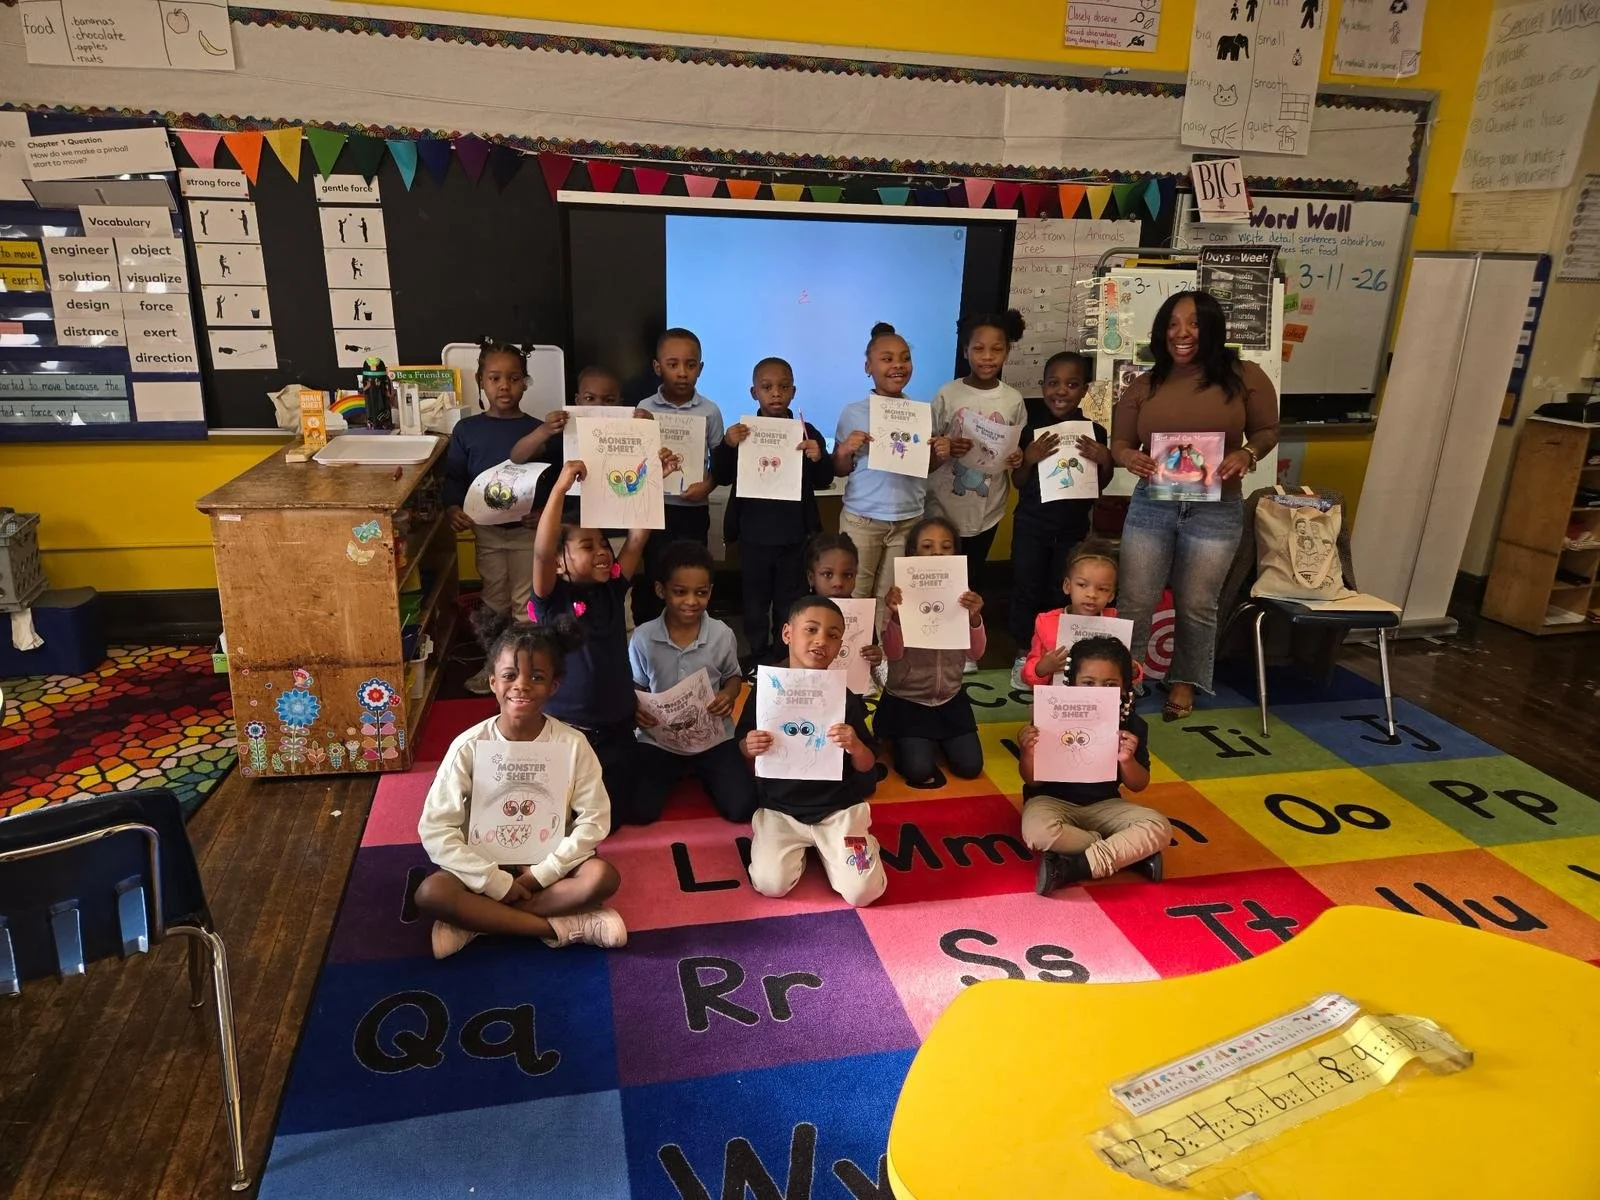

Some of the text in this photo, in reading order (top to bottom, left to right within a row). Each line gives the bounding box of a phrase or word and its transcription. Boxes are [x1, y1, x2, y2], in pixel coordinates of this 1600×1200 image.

[24, 14, 56, 35] food
[1195, 27, 1212, 48] big
[1257, 32, 1285, 47] small
[1183, 122, 1207, 134] noisy
[28, 139, 59, 149] Chapter
[68, 137, 103, 145] Question
[31, 151, 48, 159] How
[74, 147, 95, 155] make
[104, 145, 129, 155] pinball
[33, 160, 51, 168] start
[186, 178, 240, 188] strong force
[1196, 161, 1242, 201] BIG
[321, 184, 373, 193] gentle force
[1250, 202, 1351, 232] Word Wall
[88, 217, 151, 229] Vocabulary
[1016, 224, 1037, 240] ood
[1086, 224, 1125, 242] Animals
[1209, 232, 1229, 241] can
[51, 245, 109, 256] engineer
[131, 244, 171, 257] object
[1206, 252, 1230, 263] Days
[1240, 252, 1268, 263] Week
[58, 272, 111, 282] solution
[127, 272, 182, 284] visualize
[66, 299, 110, 311] design
[140, 301, 174, 311] force
[63, 327, 119, 337] distance
[143, 327, 178, 337] exert
[135, 353, 193, 363] direction
[414, 371, 440, 379] Friend
[65, 379, 100, 391] because
[599, 437, 642, 446] MONSTER
[607, 445, 634, 453] SHEET
[919, 579, 942, 587] SHEET
[777, 689, 823, 698] MONSTER
[786, 697, 813, 705] SHEET
[1062, 711, 1089, 719] SHEET
[1181, 725, 1272, 758] Ii
[497, 763, 546, 772] MONSTER
[506, 772, 536, 781] SHEET
[1428, 779, 1559, 826] Pp
[1264, 792, 1391, 835] Oo
[939, 927, 1090, 985] Ss
[676, 955, 823, 1033] Rr
